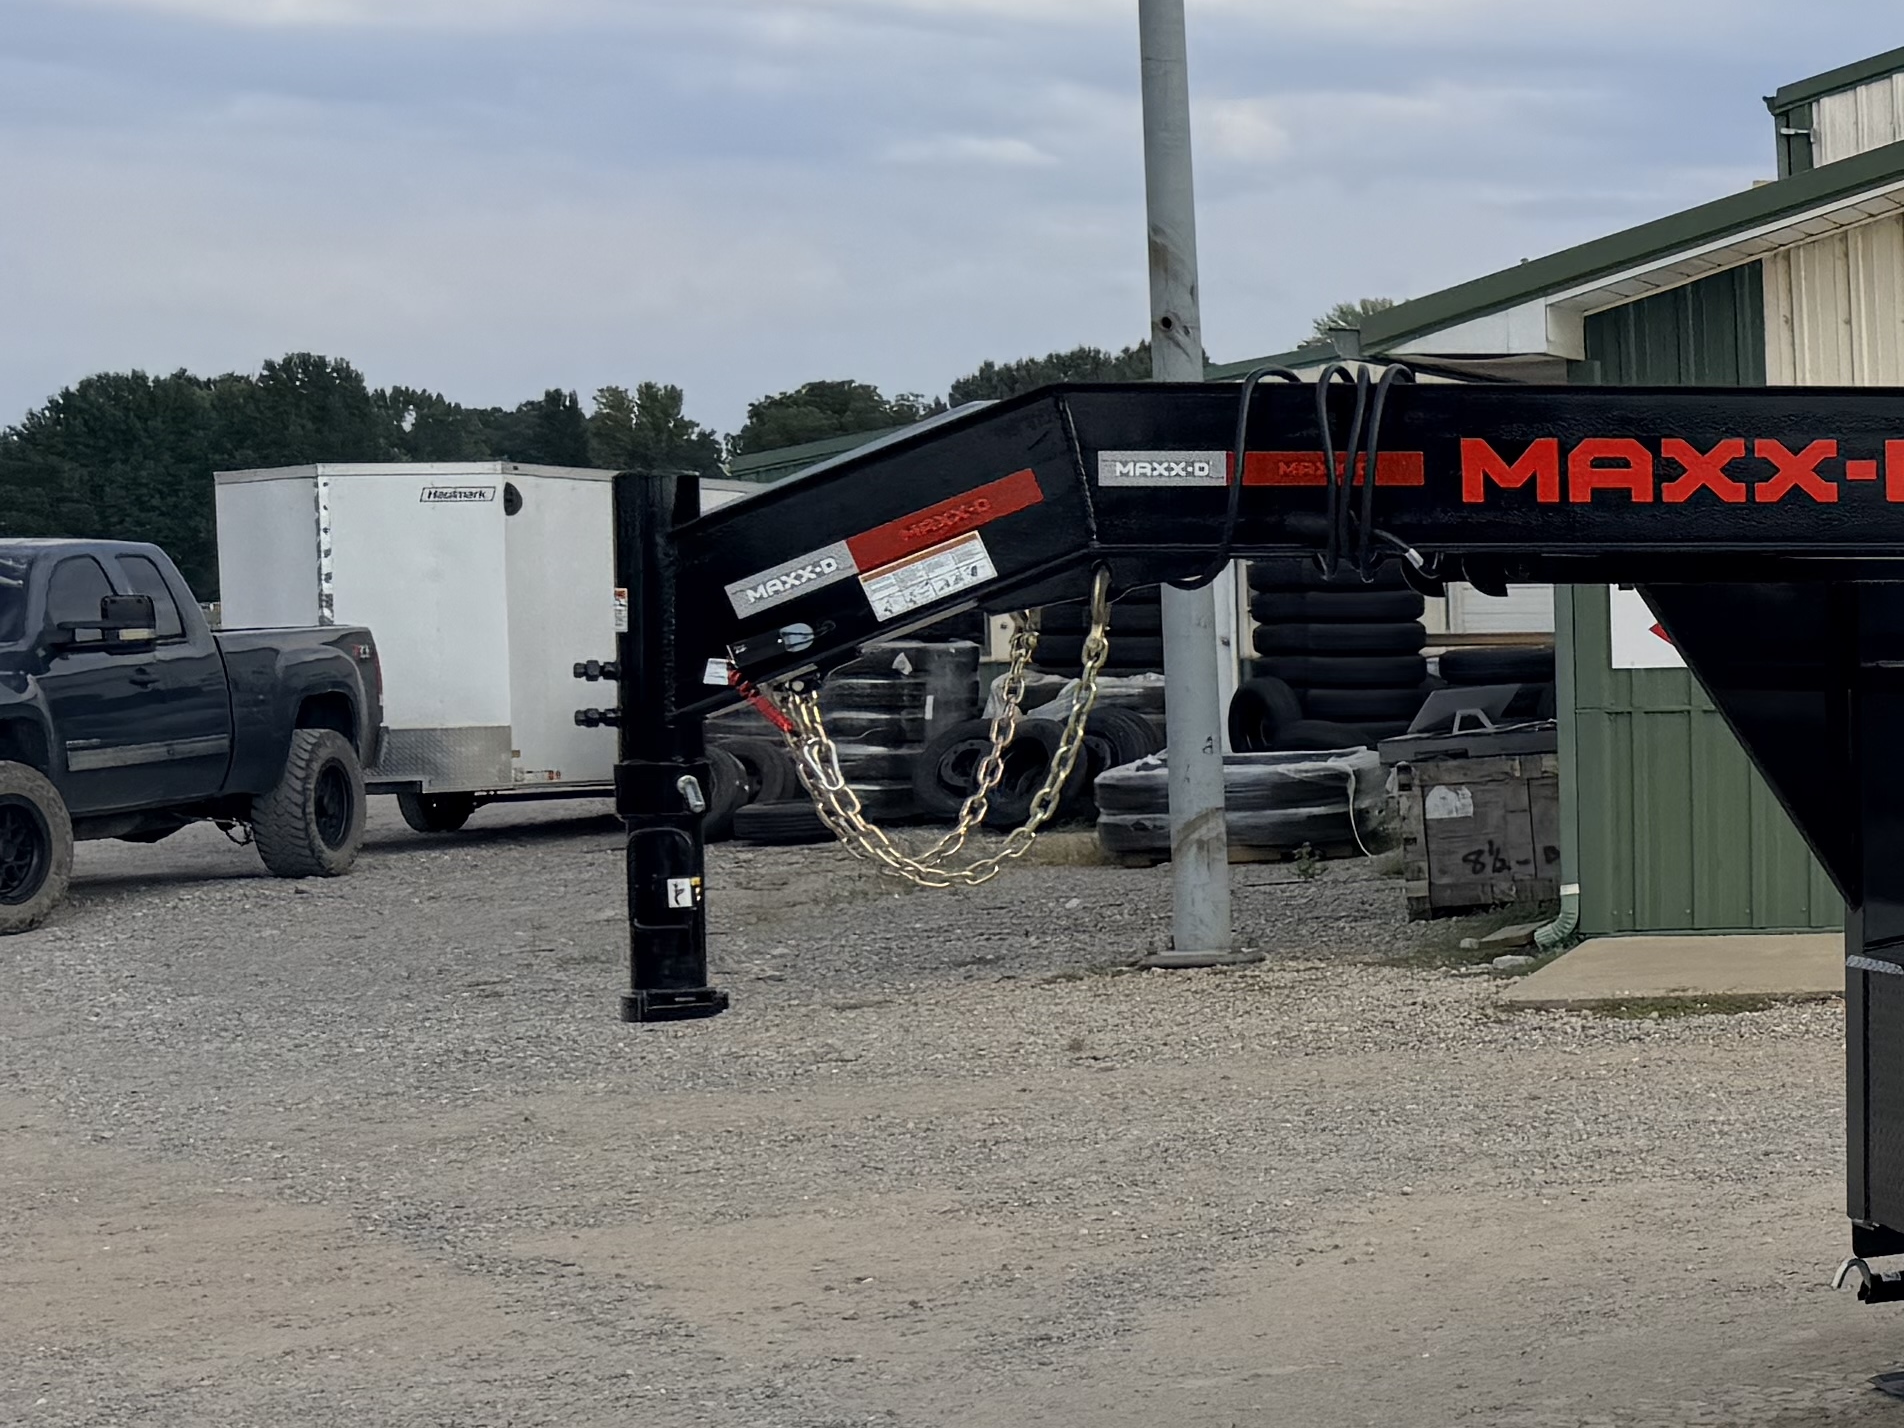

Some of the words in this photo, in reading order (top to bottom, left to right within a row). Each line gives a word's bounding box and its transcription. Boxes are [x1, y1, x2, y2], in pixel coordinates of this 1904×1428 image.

[1115, 461, 1210, 477] MAXX-D
[746, 556, 838, 604] MAXX-D
[902, 498, 991, 542] MAXX-D
